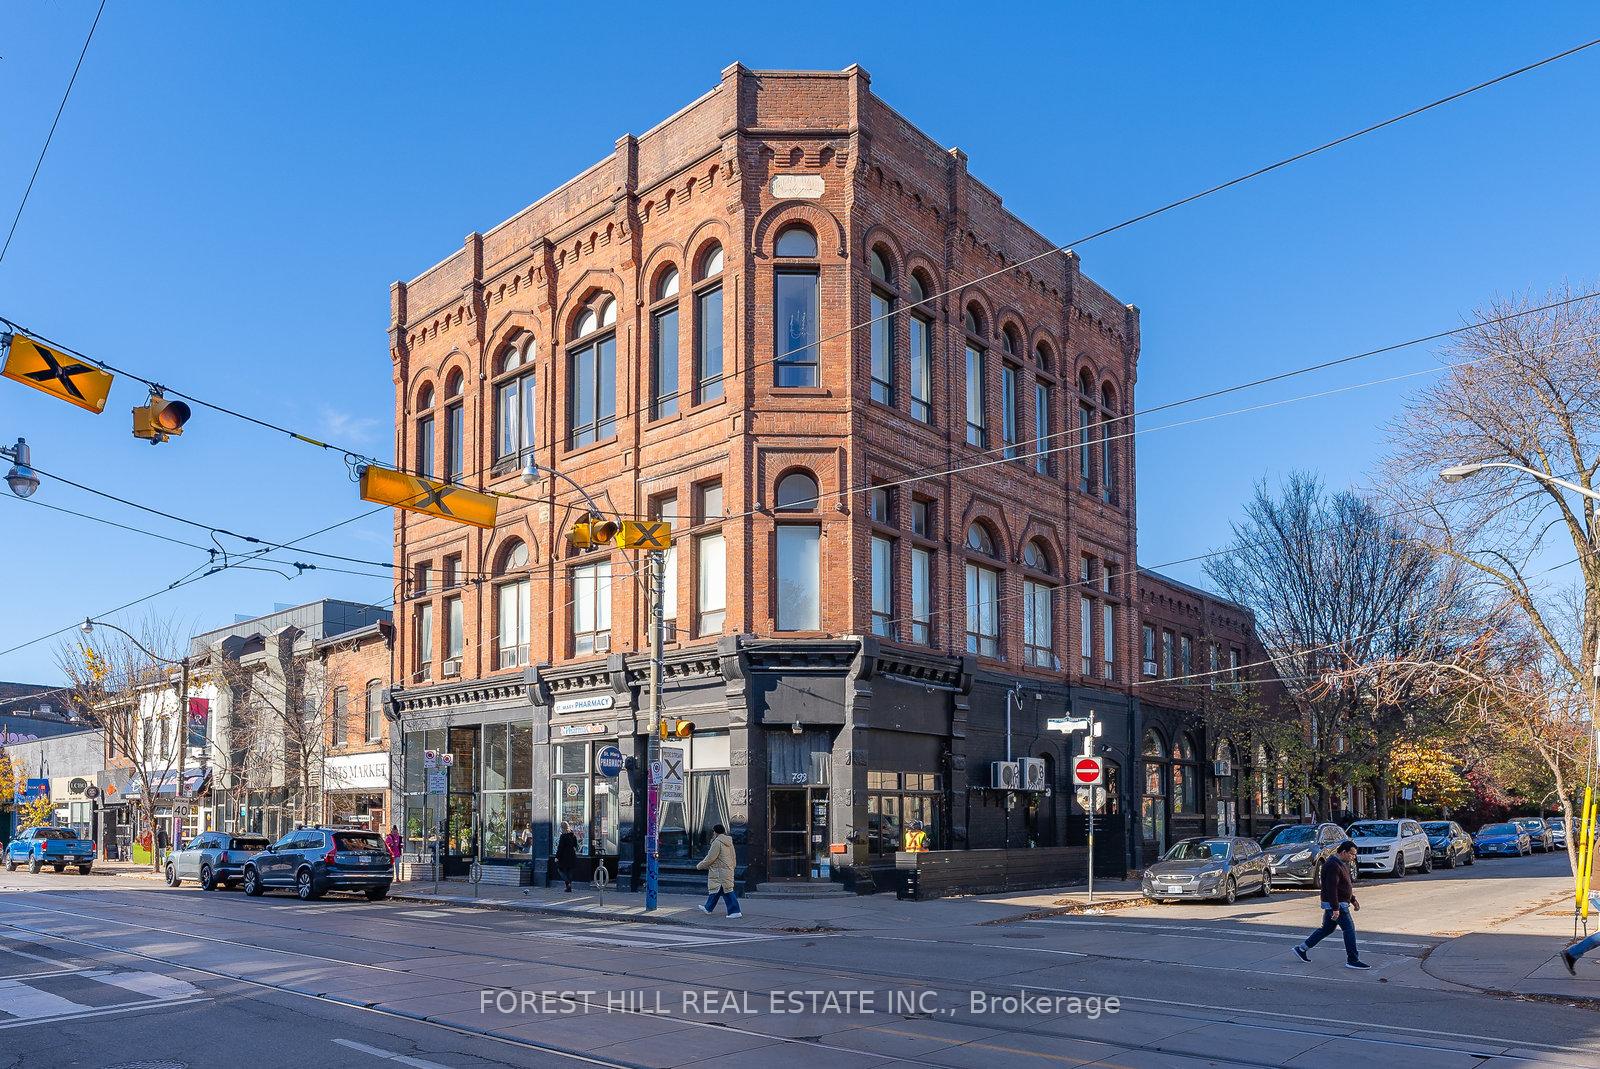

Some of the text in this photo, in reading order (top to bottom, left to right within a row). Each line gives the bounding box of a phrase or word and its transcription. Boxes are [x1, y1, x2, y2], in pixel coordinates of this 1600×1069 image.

[575, 698, 609, 708] PHARMACY
[349, 763, 387, 779] MARKET
[174, 806, 188, 816] 40
